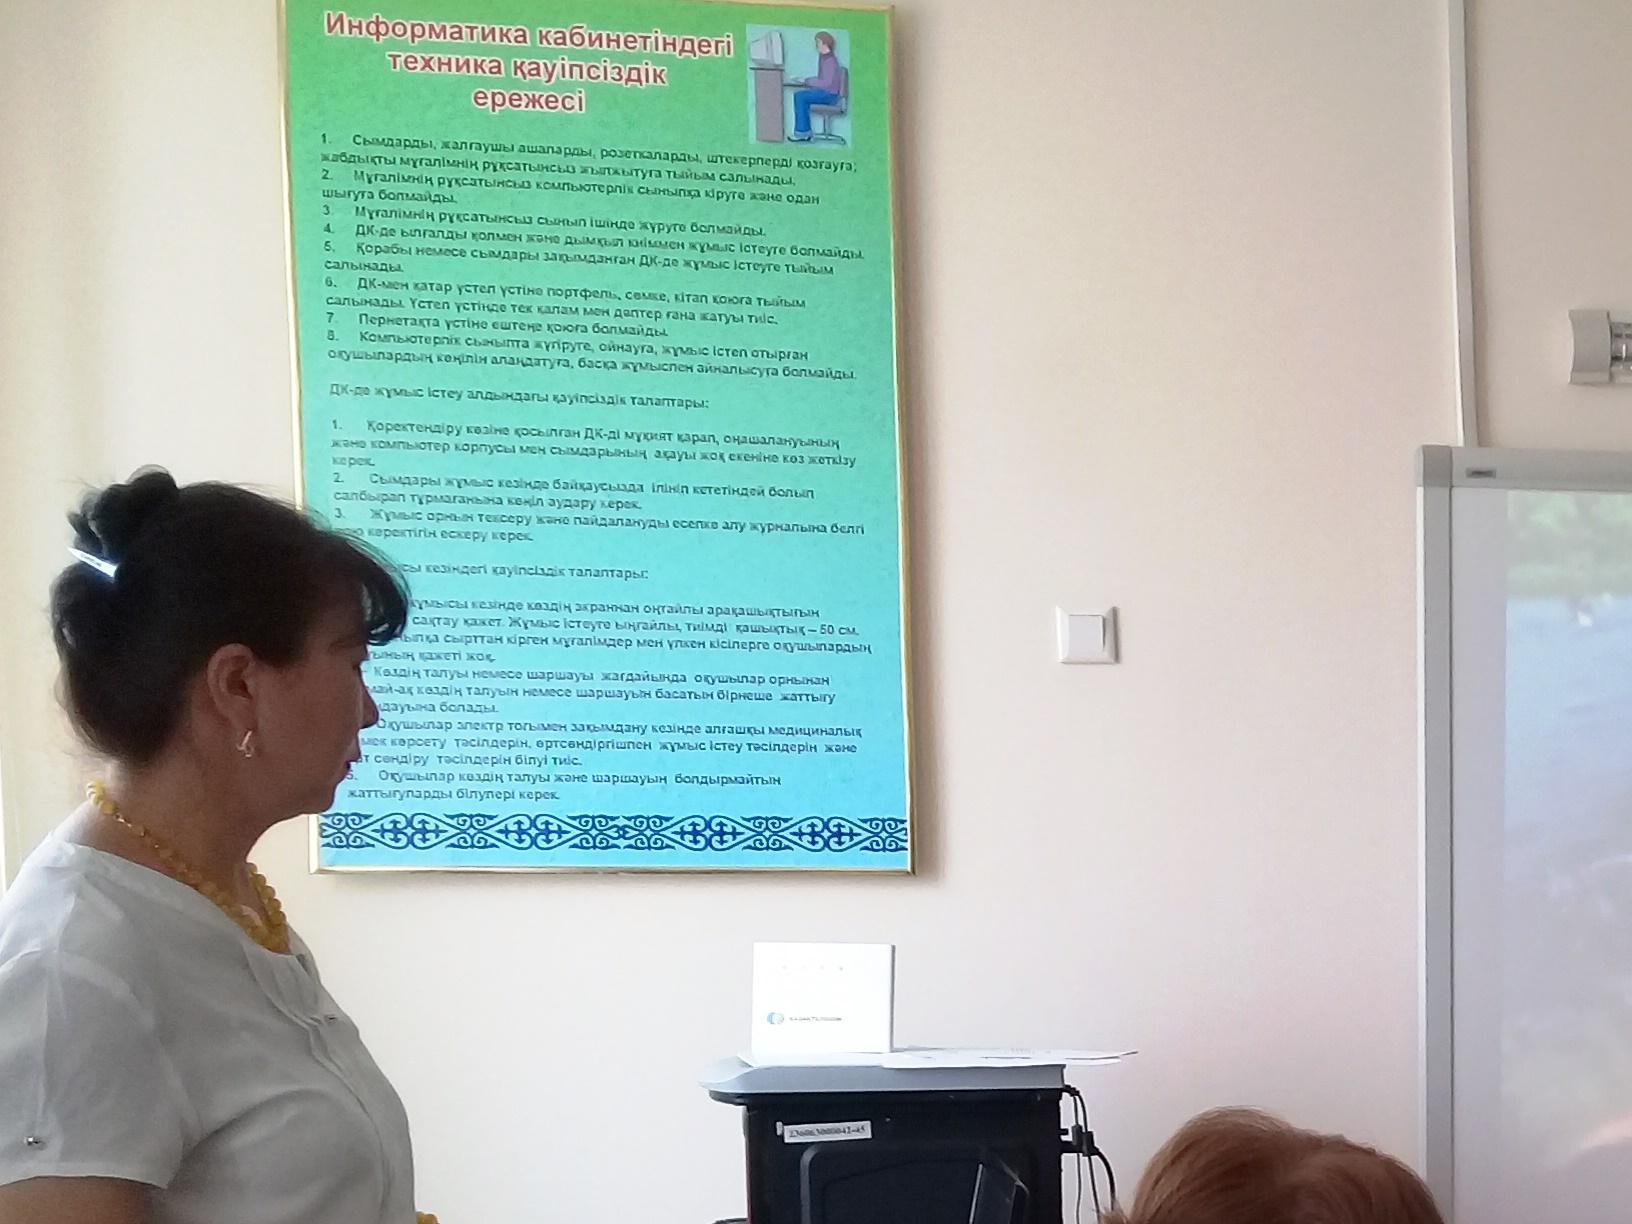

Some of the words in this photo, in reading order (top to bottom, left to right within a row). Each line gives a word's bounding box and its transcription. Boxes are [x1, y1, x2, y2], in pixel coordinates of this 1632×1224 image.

[326, 12, 528, 44] Информатика
[538, 25, 733, 57] кабинетіндегі
[388, 51, 502, 75] техника
[513, 56, 668, 85] қауіпсіздік
[473, 88, 586, 112] ережесі
